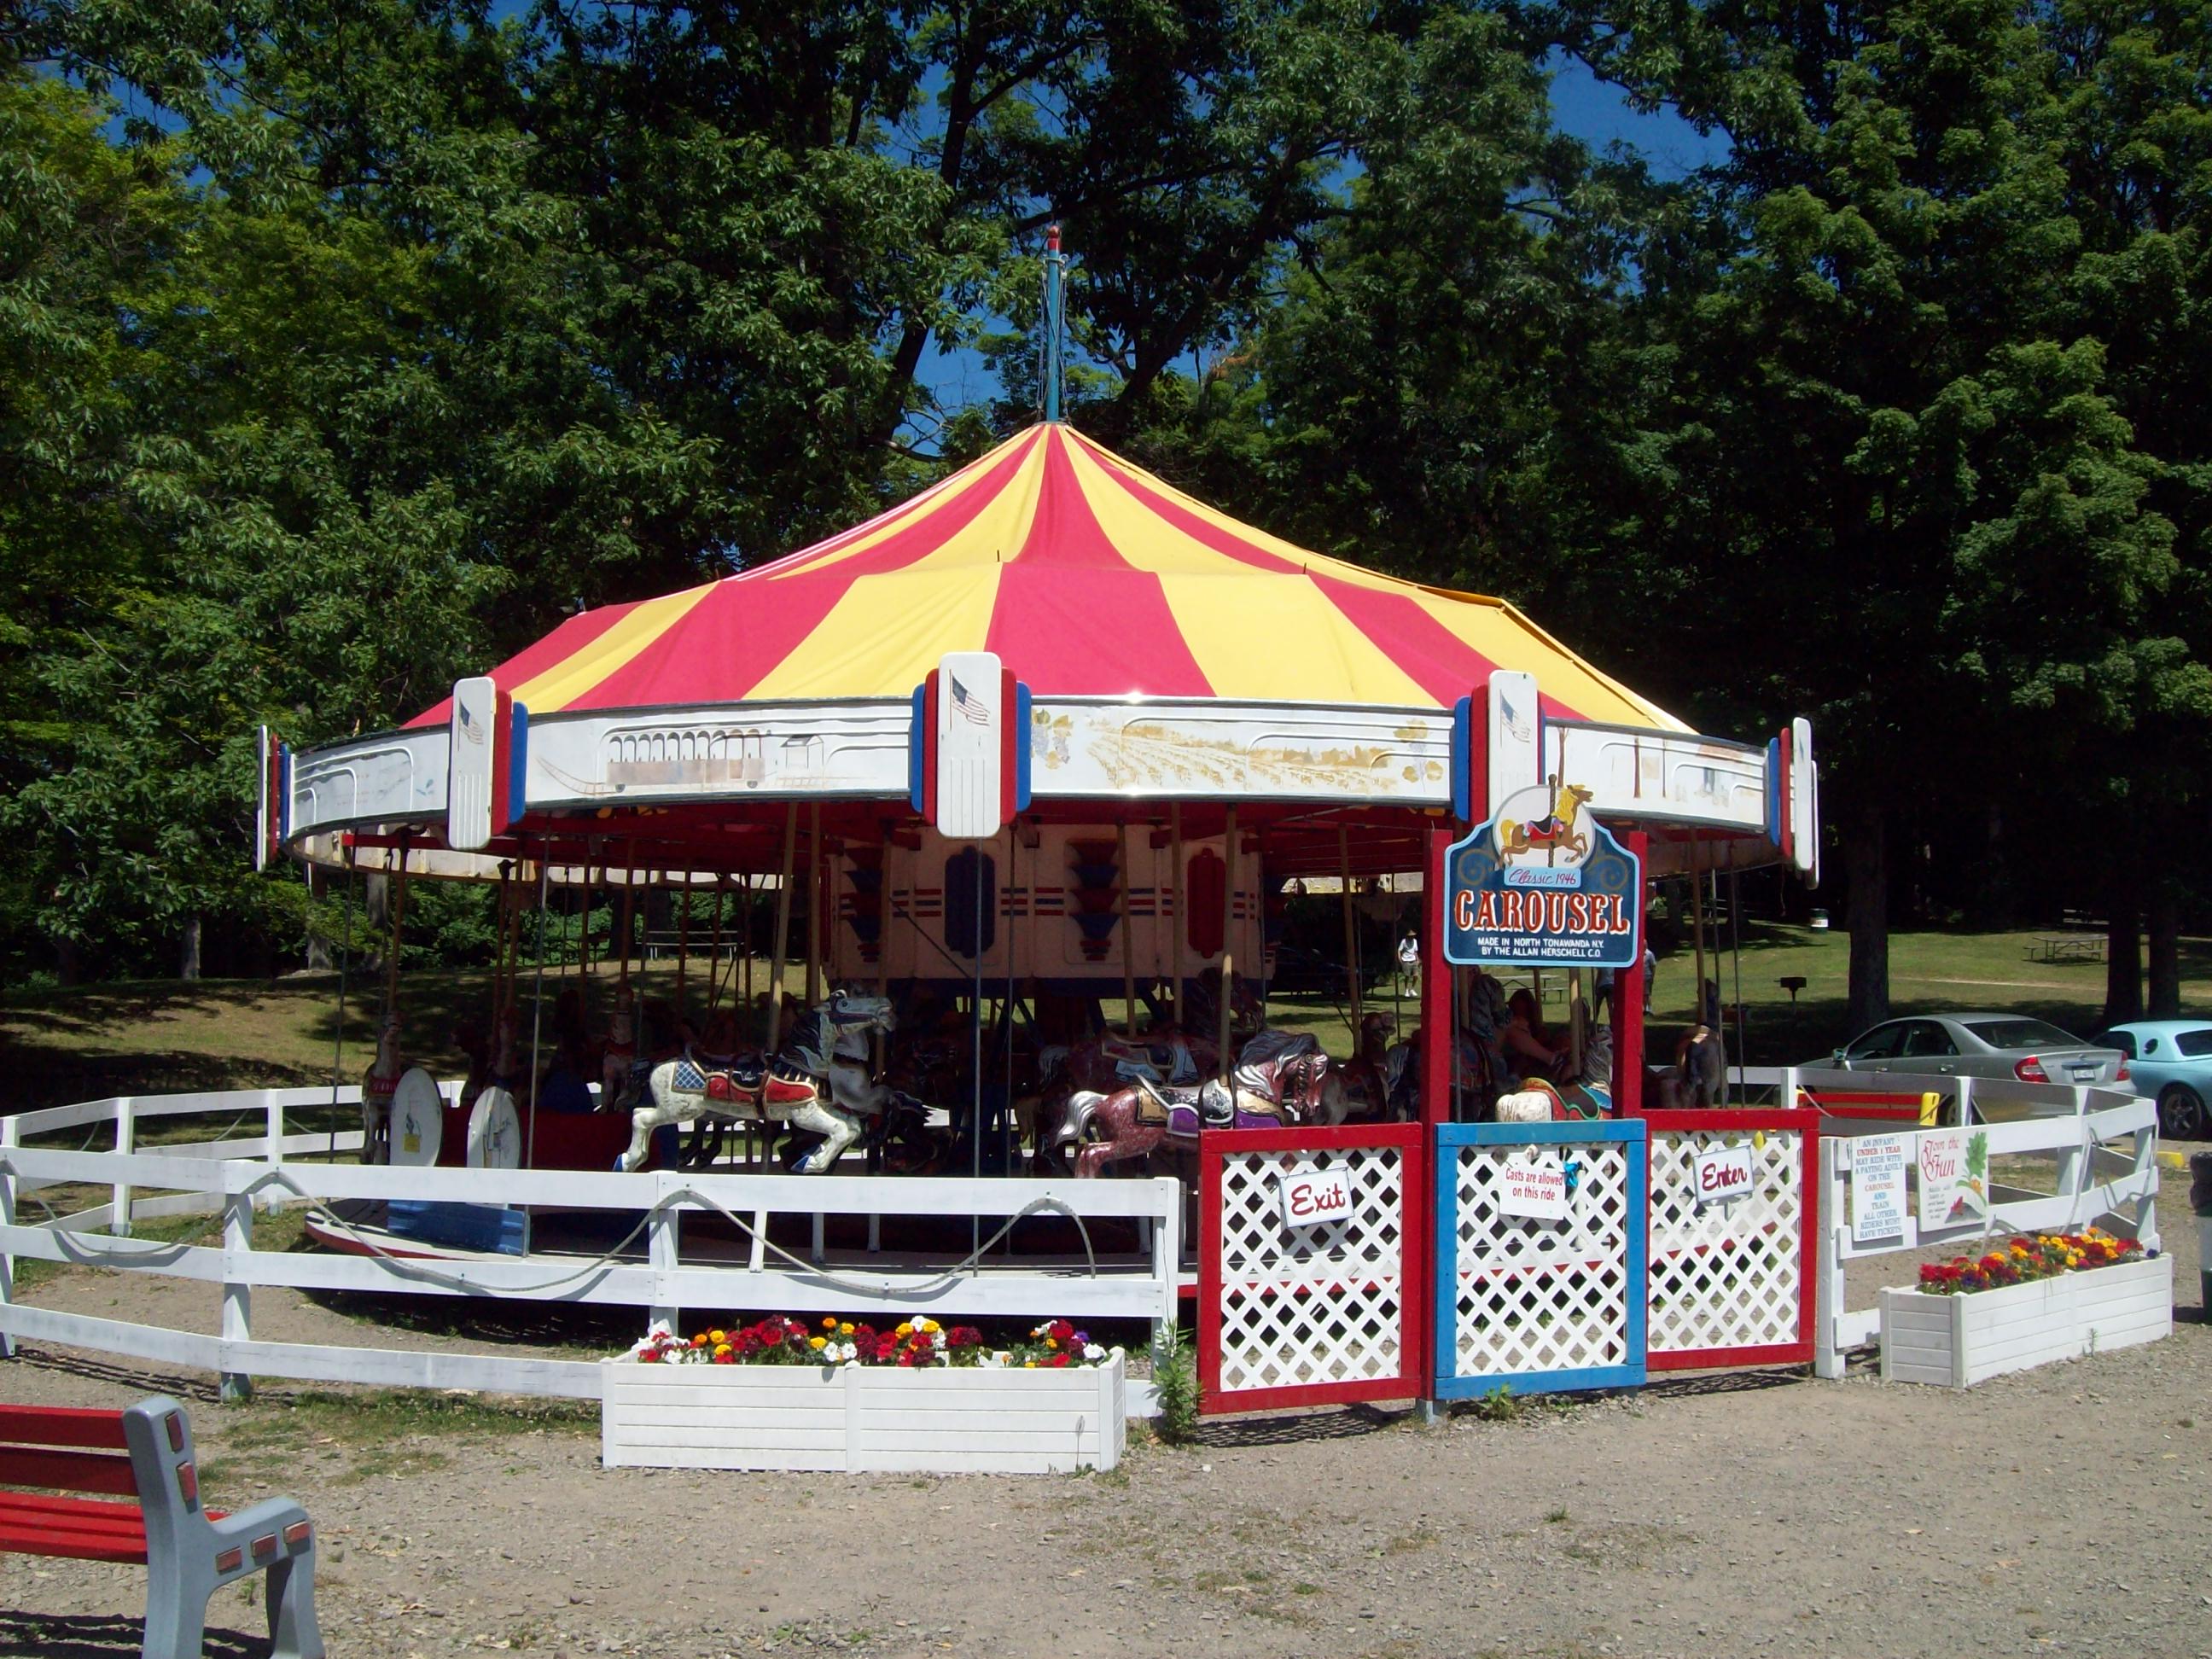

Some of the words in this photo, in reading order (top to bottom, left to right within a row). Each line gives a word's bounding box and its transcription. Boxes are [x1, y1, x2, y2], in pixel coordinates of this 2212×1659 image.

[1509, 869, 1553, 884] Classic
[1556, 873, 1576, 884] 1946
[1454, 889, 1631, 935] CAROUSEL
[1477, 937, 1499, 946] MADE
[1514, 938, 1540, 946] NORTH
[1543, 939, 1590, 948] TONAWANDA
[1481, 946, 1492, 955] BY
[1494, 947, 1511, 956] THE
[1513, 947, 1538, 956] ALLAN
[1541, 948, 1586, 957] HERSCHELL
[1872, 1138, 1895, 1147] INFANT
[1948, 1136, 1959, 1150] the
[1857, 1148, 1878, 1156] UNDER
[1885, 1145, 1901, 1154] YEAR
[1855, 1156, 1869, 1166] MAY
[1870, 1155, 1884, 1164] RIDE
[1886, 1154, 1902, 1162] WITH
[1860, 1164, 1883, 1174] PAYING
[1883, 1161, 1903, 1171] ADULT
[1925, 1155, 1956, 1182] Fun
[1505, 1167, 1524, 1182] Casts
[1526, 1173, 1537, 1183] are
[1538, 1172, 1563, 1186] allowed
[1702, 1162, 1748, 1191] Enter
[1865, 1182, 1895, 1191] CAROUSEL
[1512, 1187, 1522, 1196] on
[1524, 1185, 1539, 1199] this
[1540, 1187, 1556, 1201] ride
[1874, 1191, 1886, 1200] AND
[1291, 1183, 1346, 1216] Exit
[1871, 1201, 1889, 1210] TRAIN
[1877, 1209, 1898, 1219] OTHER
[1860, 1220, 1883, 1229] RIDERS
[1877, 1225, 1902, 1237] TICKETS
